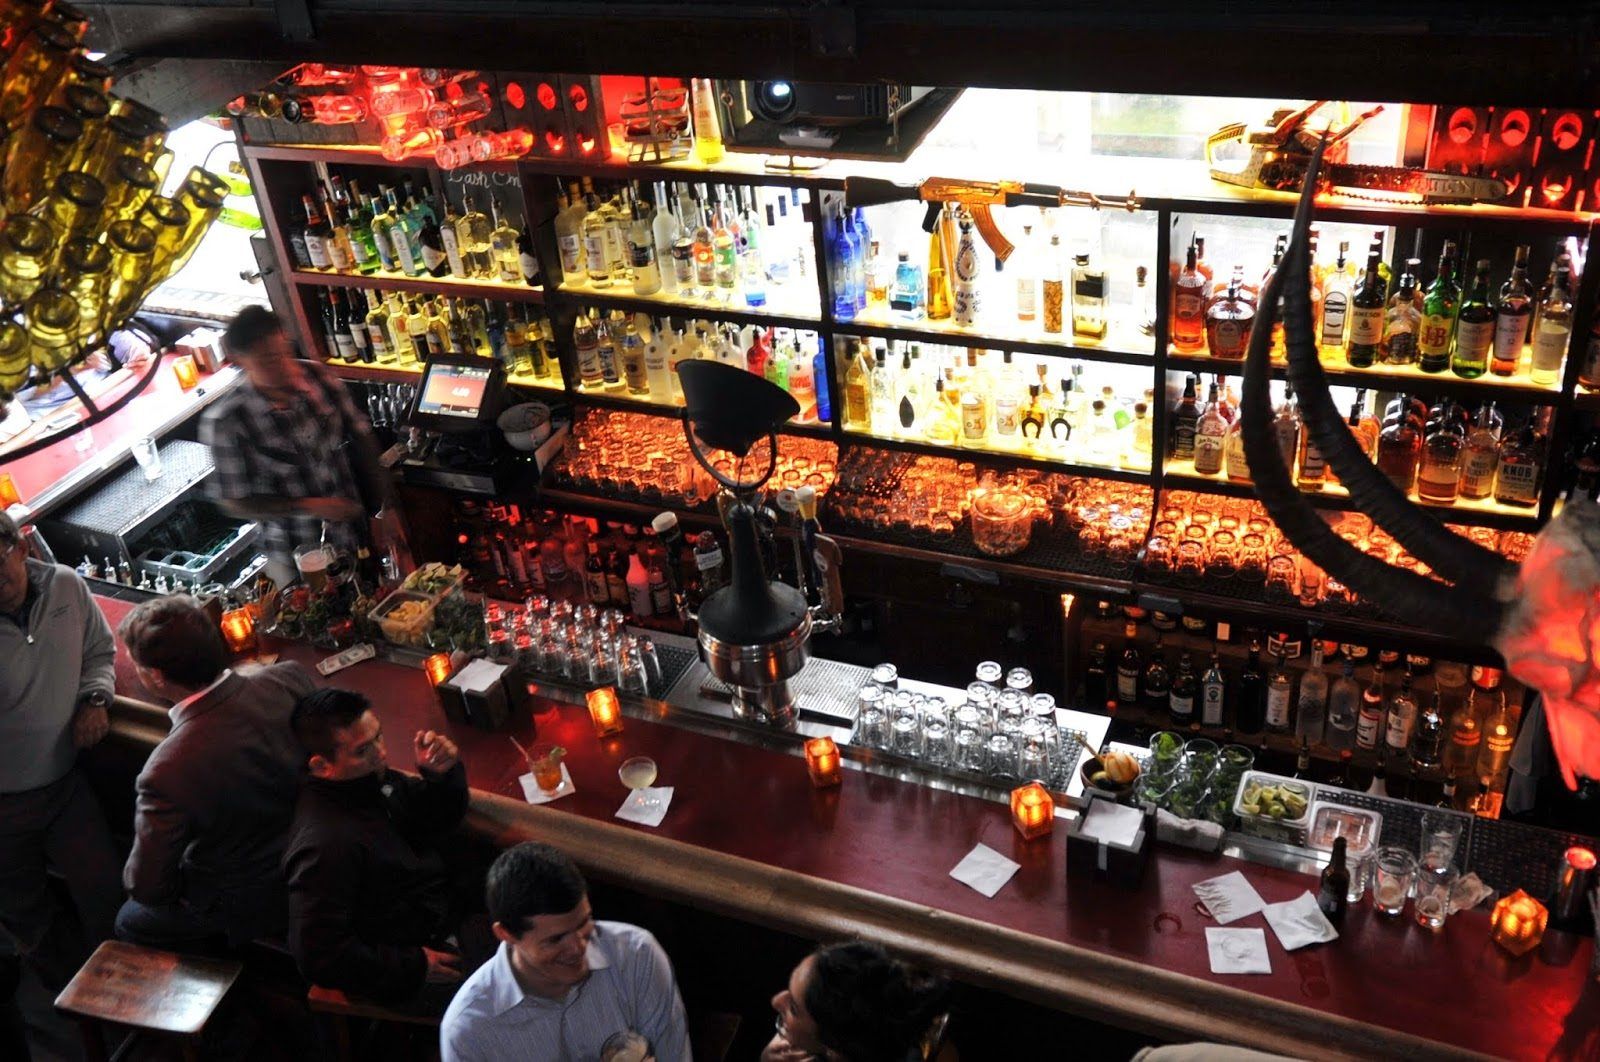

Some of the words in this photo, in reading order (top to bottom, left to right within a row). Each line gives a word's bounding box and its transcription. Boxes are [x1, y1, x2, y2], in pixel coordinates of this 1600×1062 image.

[448, 168, 490, 188] Cash
[1421, 325, 1447, 347] J&B
[1502, 464, 1532, 478] KNOB
